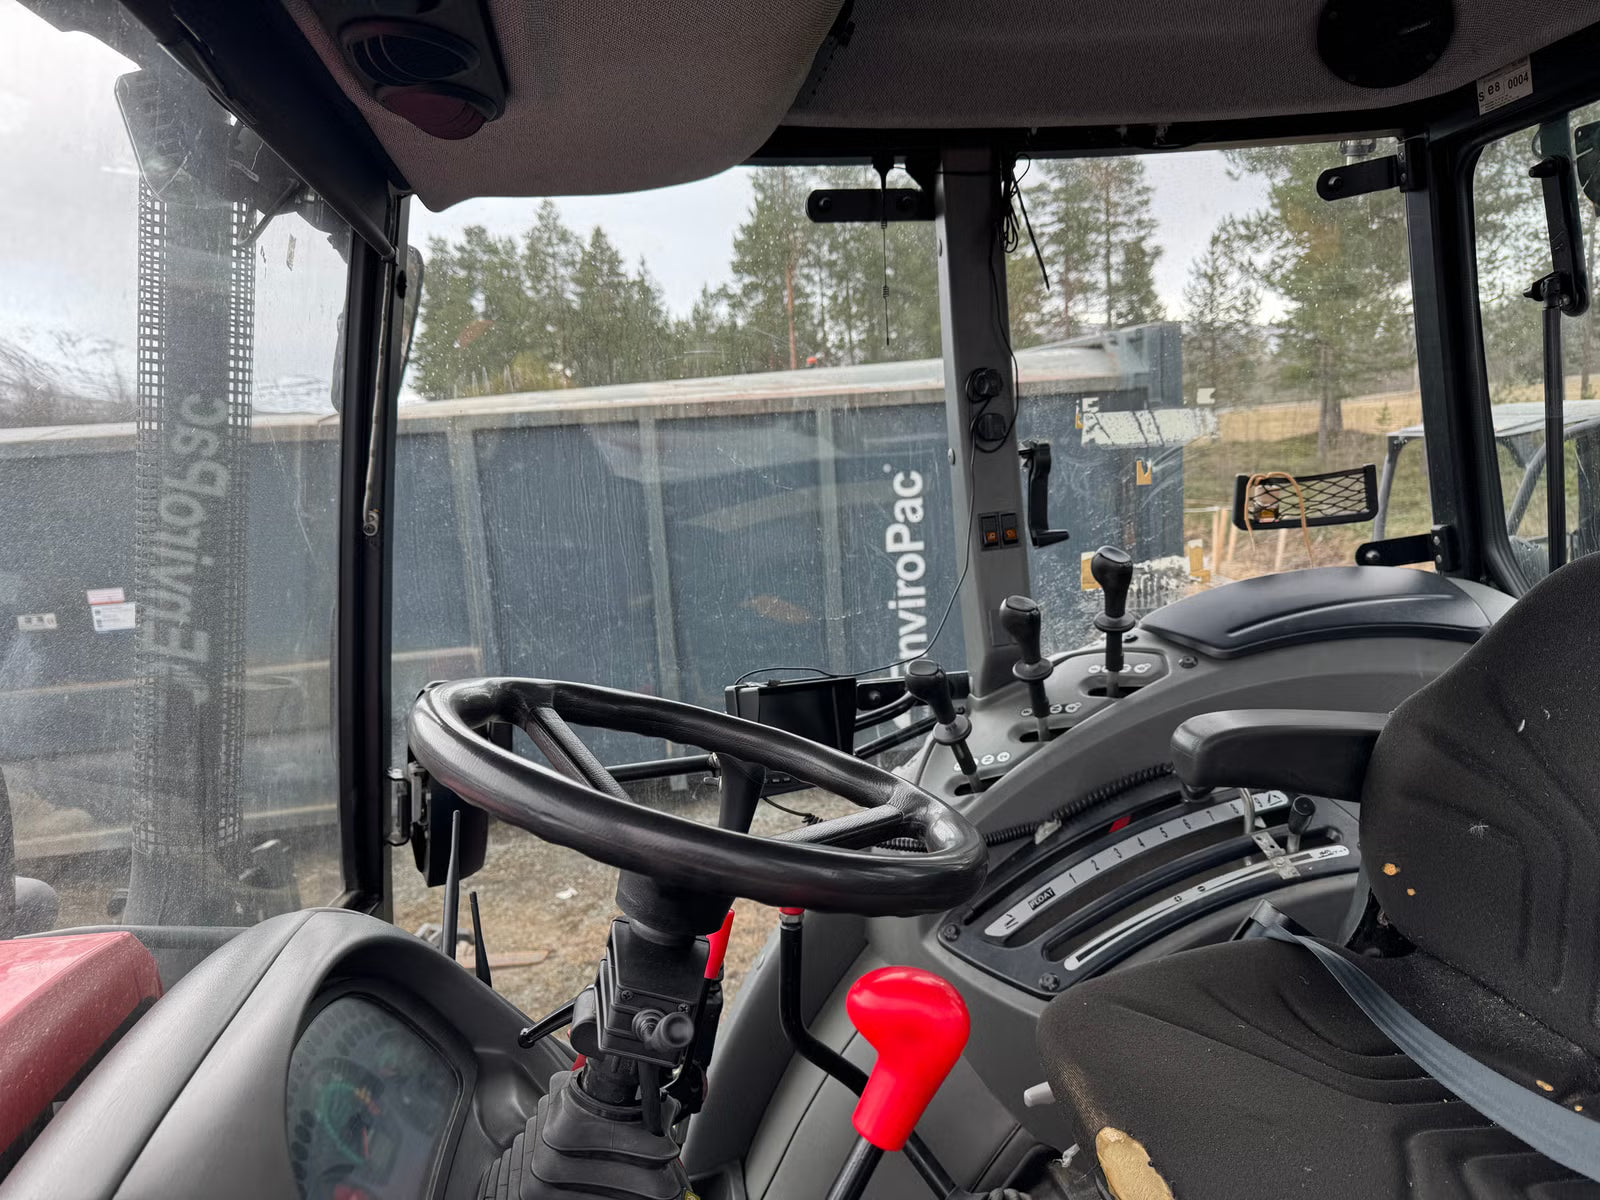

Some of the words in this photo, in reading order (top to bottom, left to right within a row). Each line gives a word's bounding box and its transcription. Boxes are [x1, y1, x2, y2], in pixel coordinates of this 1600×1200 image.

[1488, 81, 1500, 95] e8
[1508, 72, 1528, 89] 0004
[886, 470, 927, 678] nviroPac
[1029, 888, 1054, 909] FLOAT
[1091, 859, 1100, 871] 2
[1113, 847, 1122, 859] 3
[1137, 837, 1146, 848] 4
[1159, 827, 1168, 838] 5
[1183, 818, 1192, 830] 6
[1230, 803, 1239, 814] 8
